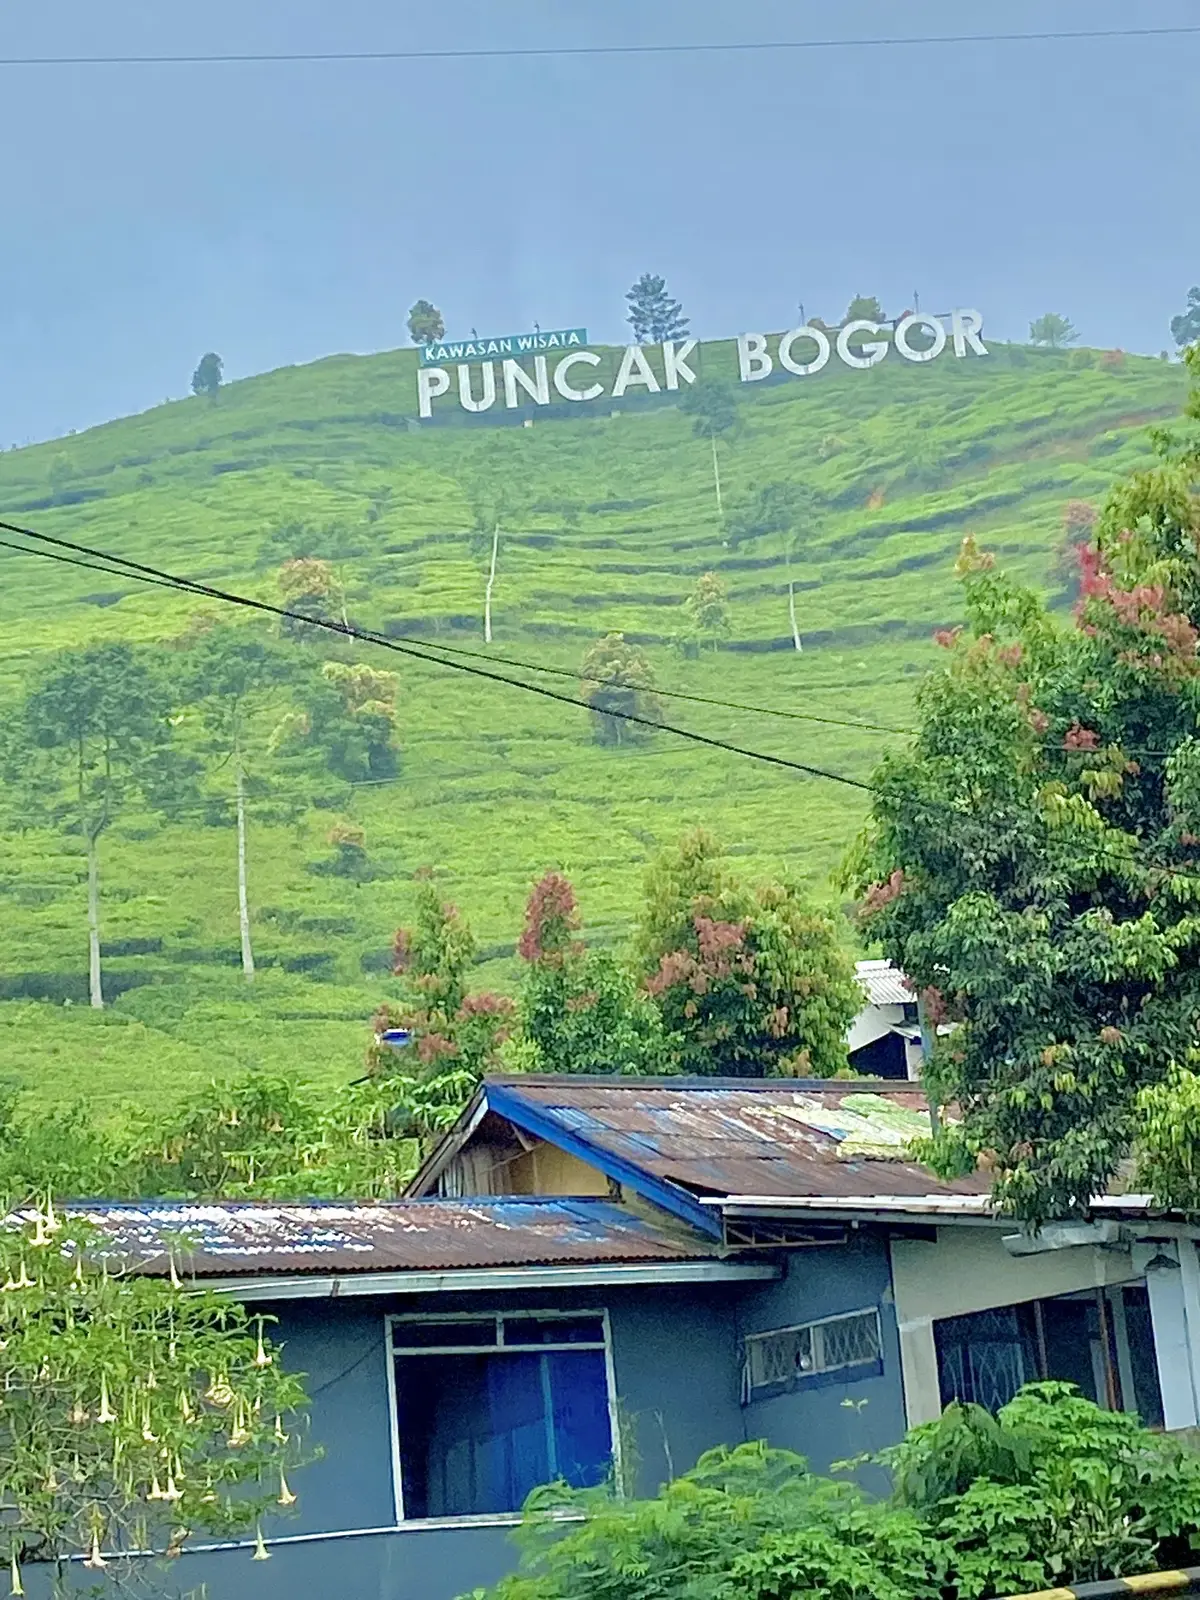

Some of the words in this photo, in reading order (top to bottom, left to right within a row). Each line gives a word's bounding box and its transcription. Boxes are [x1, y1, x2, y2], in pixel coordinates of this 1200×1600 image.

[417, 338, 700, 418] PUNCAK
[737, 307, 989, 382] BOGOR
[425, 339, 512, 361] KAWASAN
[517, 332, 580, 350] WISATA
